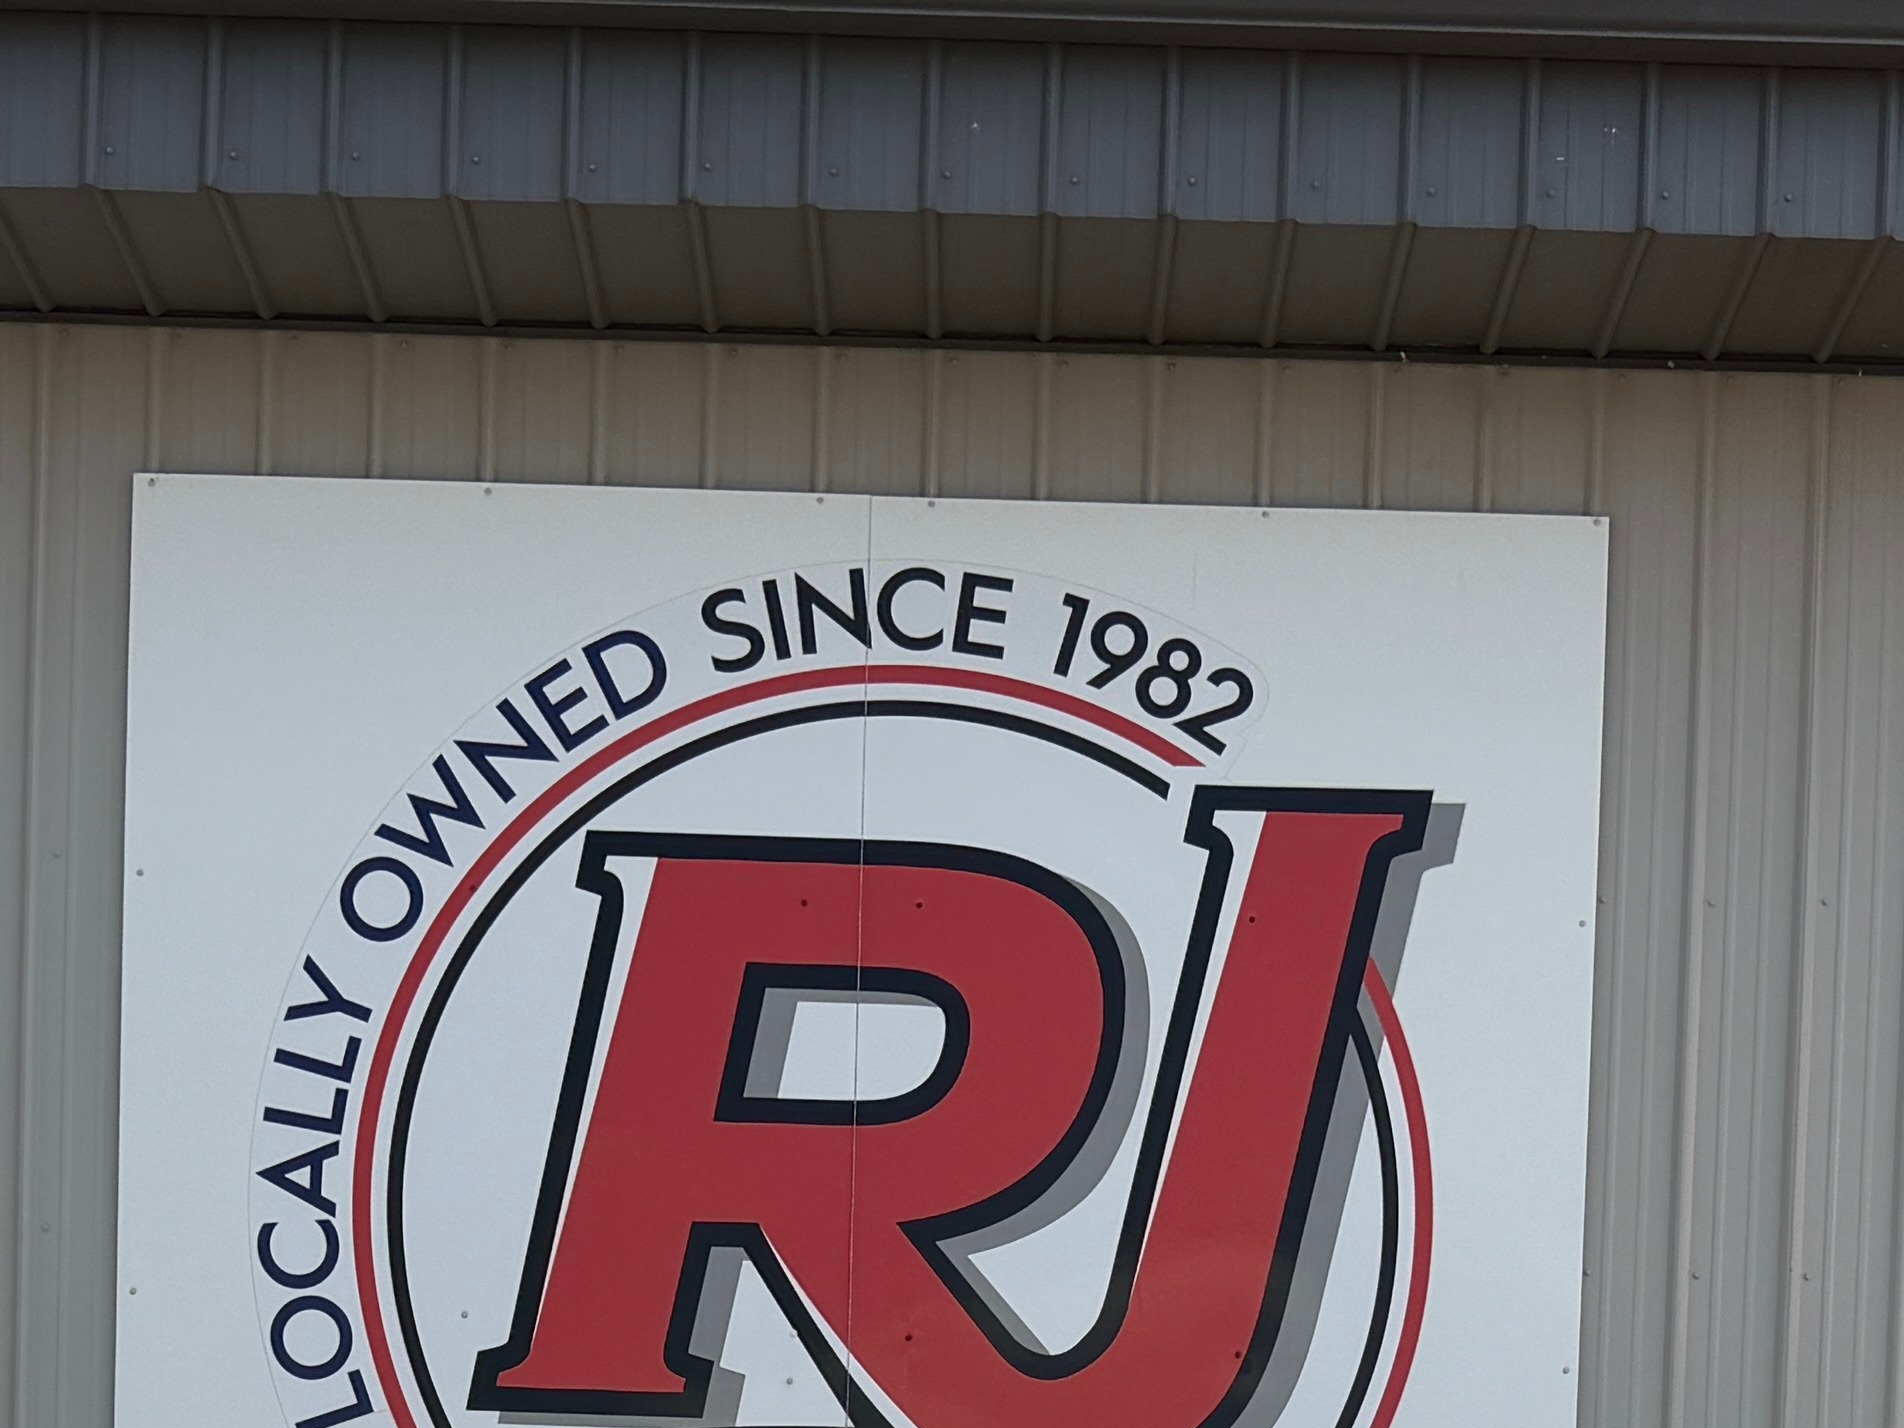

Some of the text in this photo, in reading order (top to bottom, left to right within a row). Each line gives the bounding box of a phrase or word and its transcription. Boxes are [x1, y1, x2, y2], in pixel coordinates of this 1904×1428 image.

[340, 631, 668, 943] OWNED
[702, 568, 1013, 672] SINCE
[1054, 592, 1254, 755] 1982
